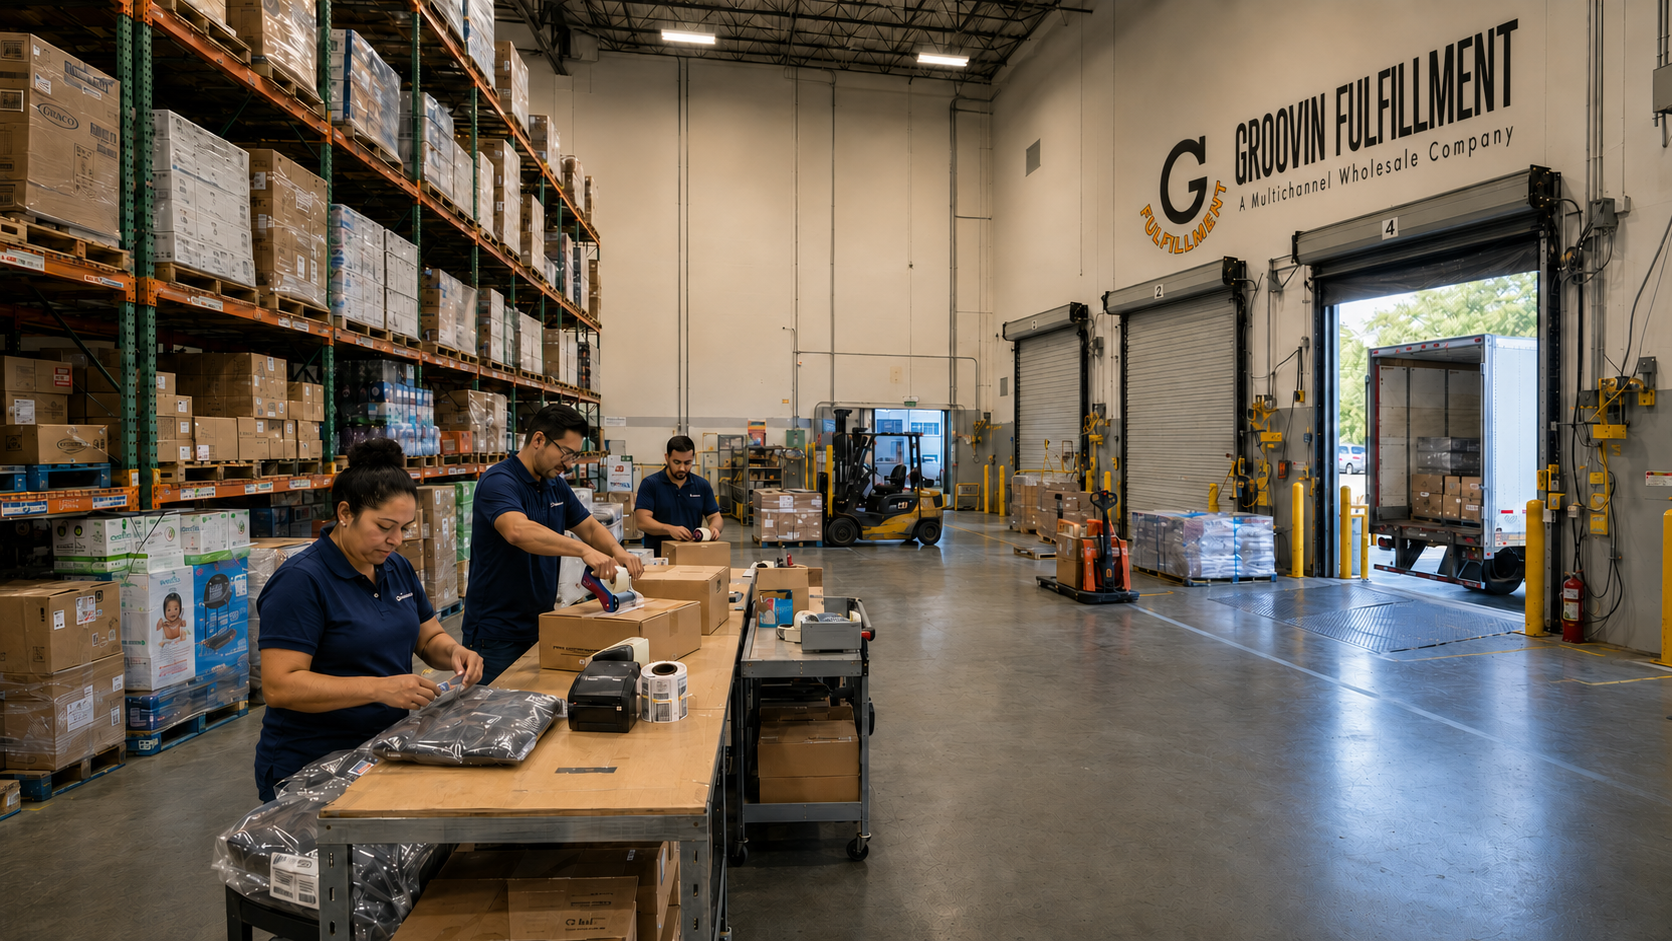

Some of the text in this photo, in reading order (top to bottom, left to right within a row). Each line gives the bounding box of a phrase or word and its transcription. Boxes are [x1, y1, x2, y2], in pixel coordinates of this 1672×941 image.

[42, 105, 75, 127] GRACO
[1235, 18, 1519, 186] GROOVIN FULFILLMENT
[1160, 135, 1208, 225] G
[1239, 125, 1514, 212] A Multichannel Wholesale Company
[1140, 180, 1227, 254] FULFILLMENT
[1385, 219, 1396, 236] 4
[1156, 285, 1162, 298] 2
